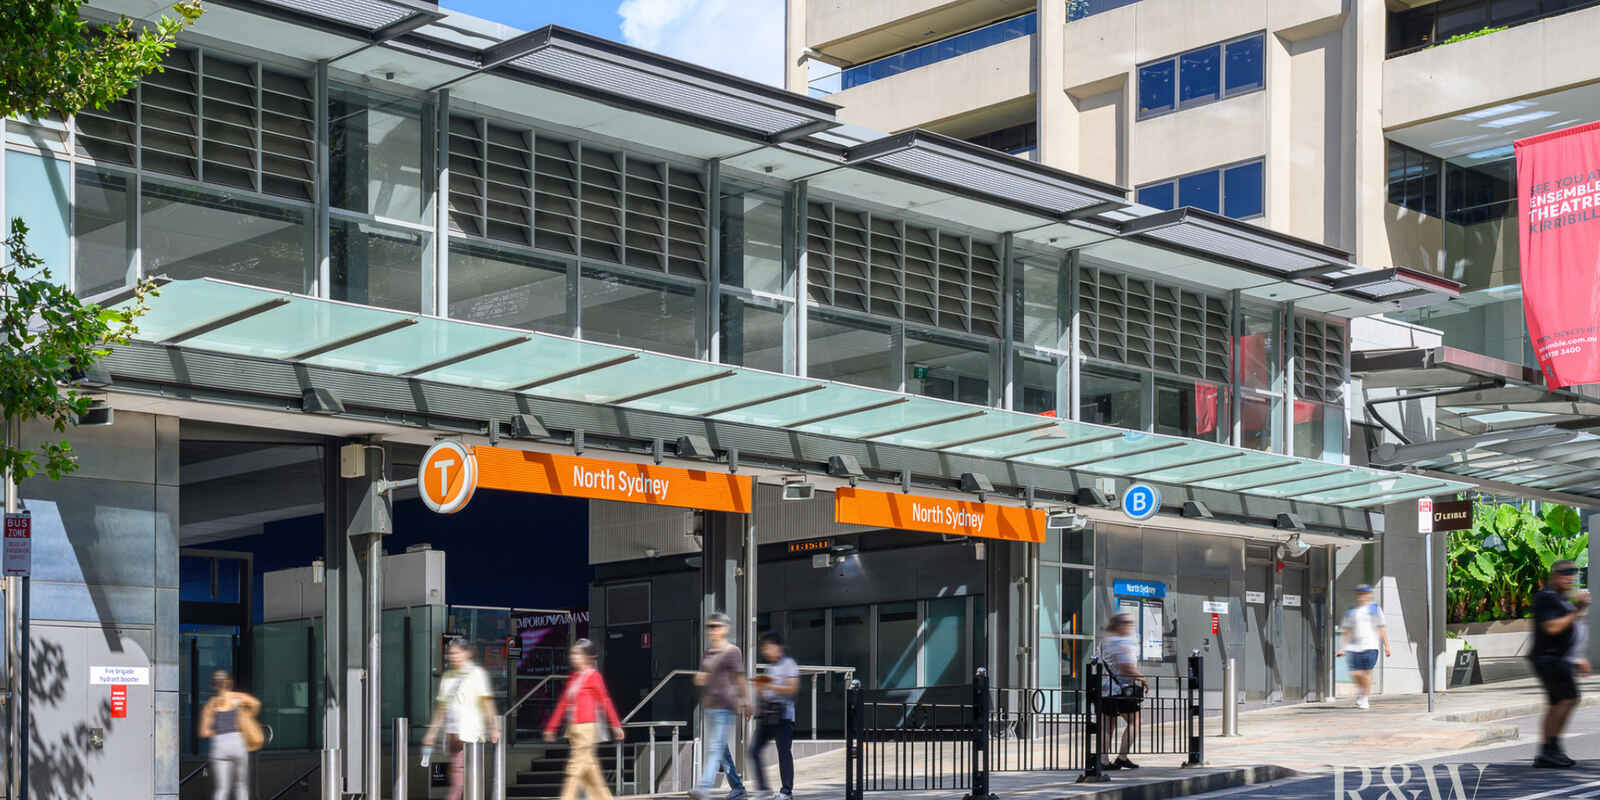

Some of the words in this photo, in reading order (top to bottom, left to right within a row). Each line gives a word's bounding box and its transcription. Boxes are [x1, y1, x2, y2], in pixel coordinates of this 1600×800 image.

[1554, 173, 1584, 189] YOU
[1530, 180, 1600, 208] ENSEMBLE
[1528, 193, 1600, 222] THEATRE
[434, 458, 455, 497] T
[573, 464, 615, 490] North
[618, 470, 669, 500] Sydney
[1133, 492, 1146, 512] B
[7, 519, 28, 527] BUS
[912, 503, 943, 525] North
[945, 506, 984, 532] Sydney
[7, 528, 27, 537] ZONE
[1126, 583, 1140, 593] North
[1140, 585, 1156, 595] Sydney
